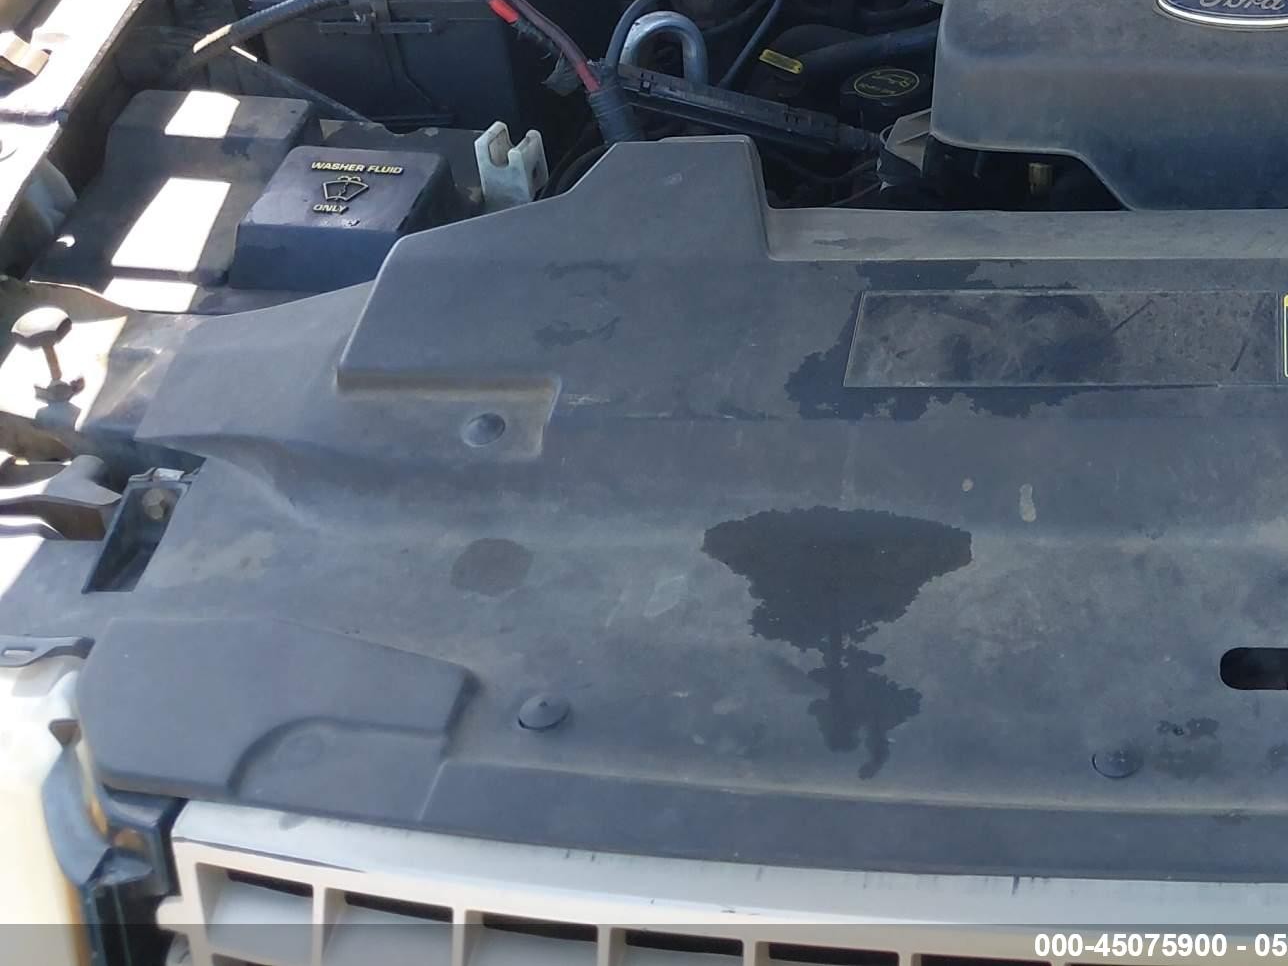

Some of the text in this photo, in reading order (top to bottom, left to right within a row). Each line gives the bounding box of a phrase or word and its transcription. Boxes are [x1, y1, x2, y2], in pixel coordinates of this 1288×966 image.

[311, 161, 404, 175] WASHER FLUID
[312, 203, 349, 214] ONLY
